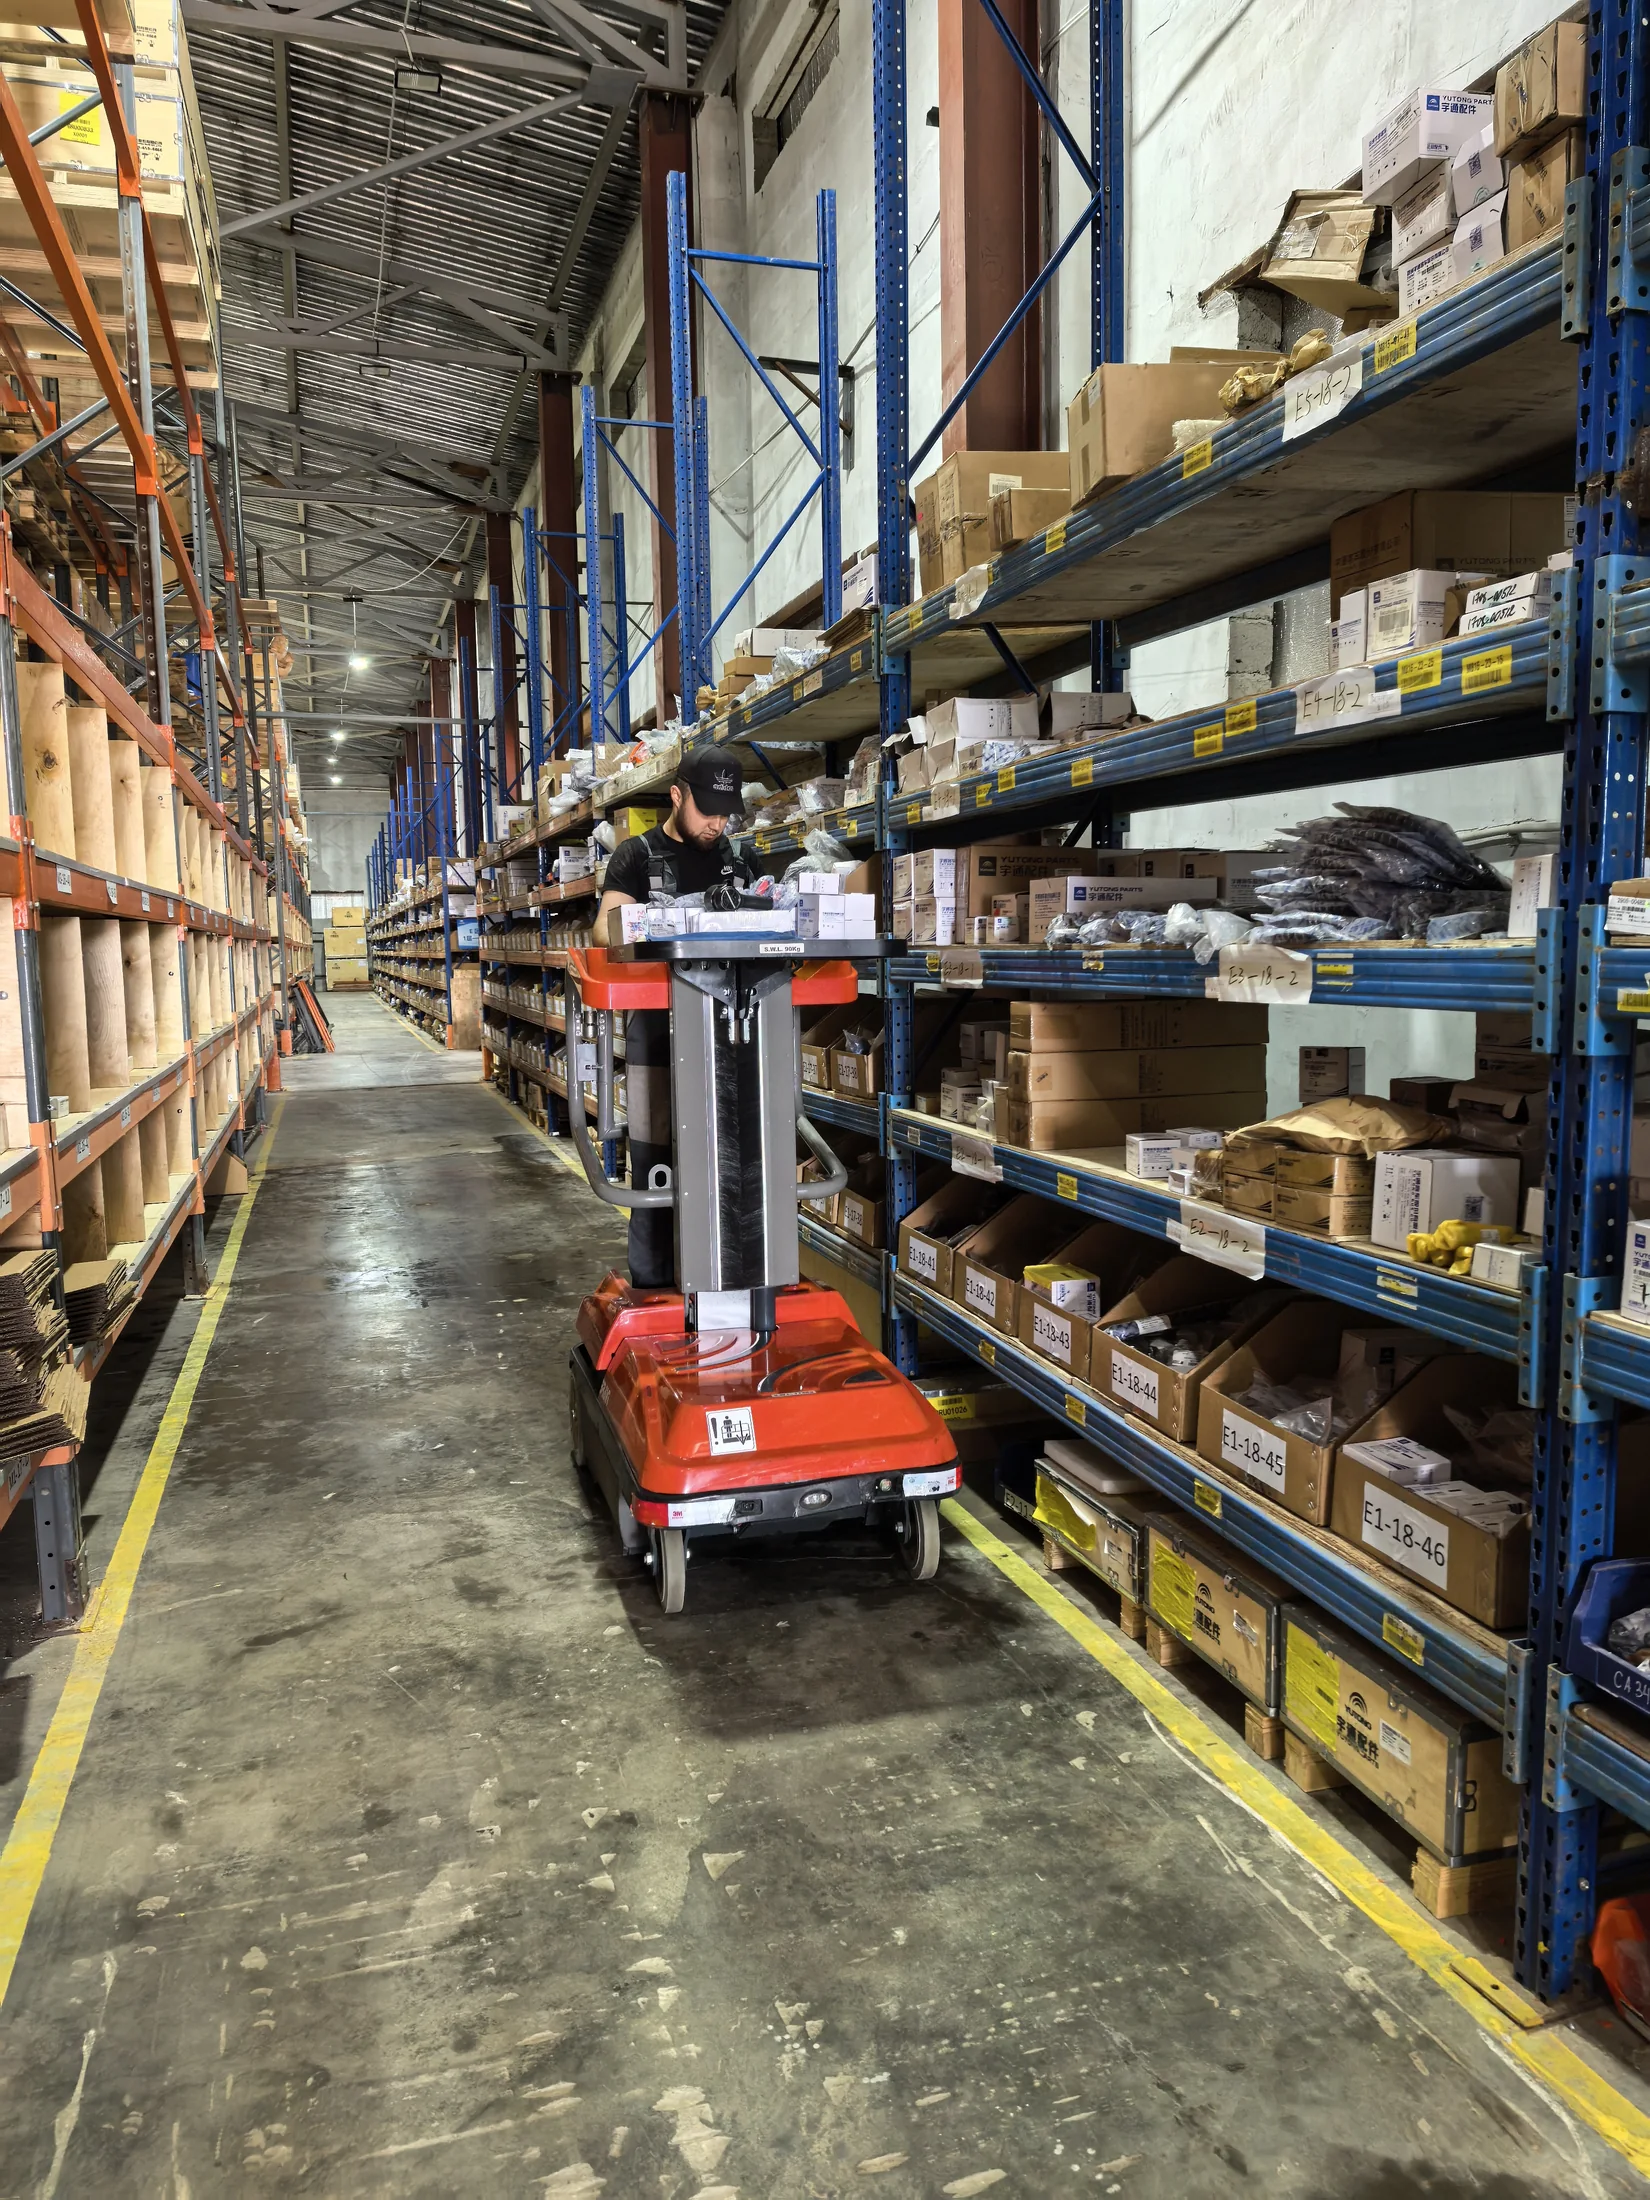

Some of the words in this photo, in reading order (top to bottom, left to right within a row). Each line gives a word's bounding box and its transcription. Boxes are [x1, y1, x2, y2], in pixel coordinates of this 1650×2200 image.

[1442, 95, 1472, 103] YUTONG
[1302, 681, 1364, 719] E4-18-2
[1000, 856, 1044, 865] YUTONG
[1045, 856, 1080, 864] PARTS
[1228, 965, 1299, 986] E3-18-2
[1189, 1218, 1250, 1252] E2-18-2
[909, 1246, 936, 1271] E1-18-41
[965, 1277, 995, 1307] E1-18-42
[1033, 1315, 1070, 1350] E1-18-43
[1111, 1362, 1157, 1404] E1-18-44
[1222, 1425, 1284, 1476] E1-18-45
[1363, 1500, 1446, 1567] E1-18-46
[1345, 1703, 1372, 1731] YUTONG
